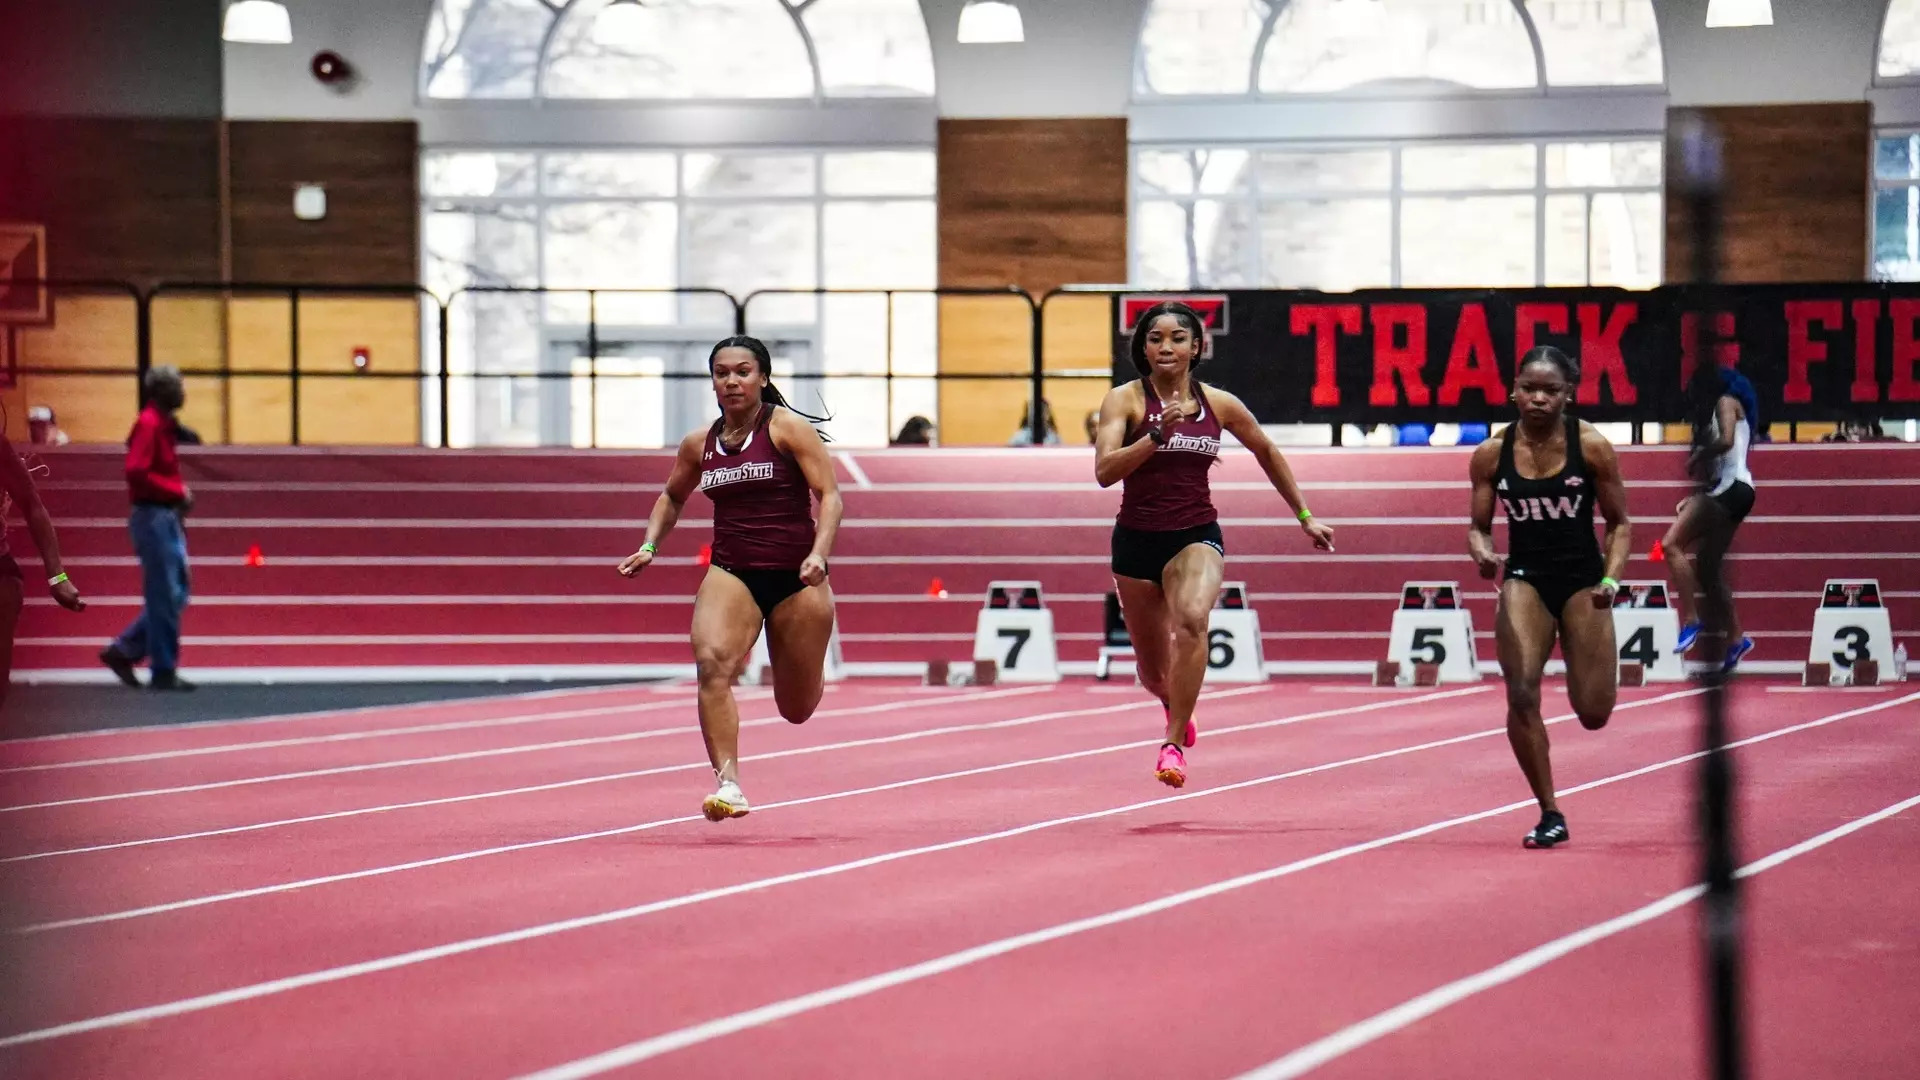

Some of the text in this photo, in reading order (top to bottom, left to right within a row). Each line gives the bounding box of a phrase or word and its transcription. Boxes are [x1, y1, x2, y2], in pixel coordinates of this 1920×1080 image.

[713, 469, 742, 484] MEXICO
[742, 464, 770, 480] STATE
[1502, 494, 1582, 521] UIW
[997, 628, 1031, 668] 7
[1207, 628, 1235, 669] 6
[1410, 628, 1446, 665] 5
[1619, 626, 1659, 668] 4
[1832, 626, 1870, 668] 3
